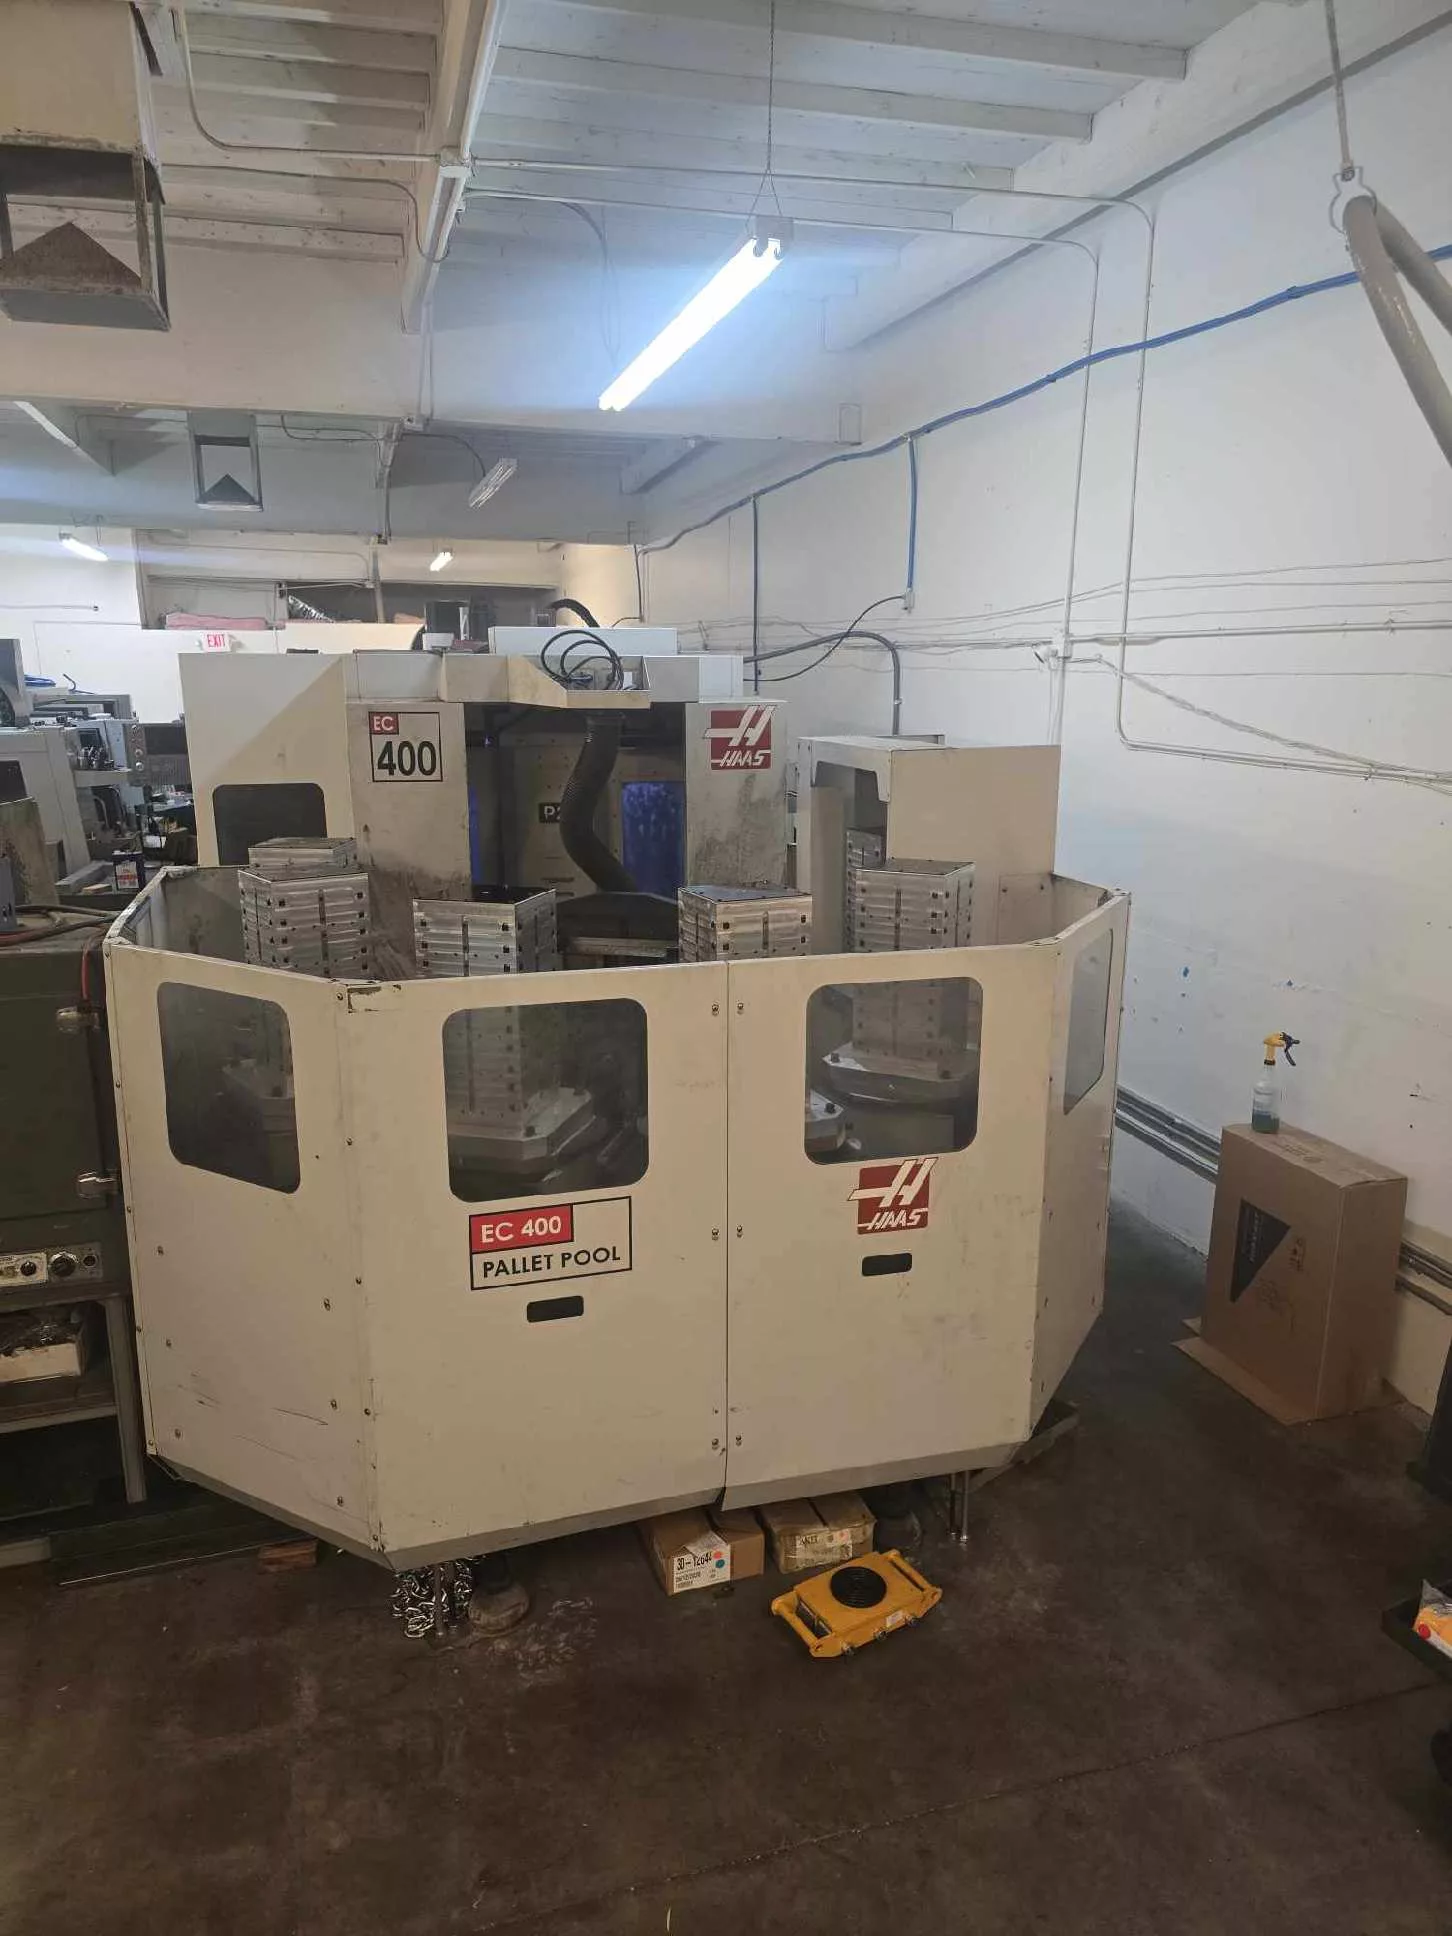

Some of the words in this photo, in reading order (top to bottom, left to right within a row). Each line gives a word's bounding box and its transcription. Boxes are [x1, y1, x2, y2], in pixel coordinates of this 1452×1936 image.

[207, 633, 226, 648] EXIT
[373, 715, 394, 731] EC
[377, 740, 437, 776] 400
[711, 749, 771, 768] HAAS
[480, 1222, 514, 1244] EC
[520, 1215, 562, 1237] 400
[857, 1207, 929, 1231] HAAS
[483, 1254, 554, 1278] PALLET
[561, 1246, 621, 1268] POOL
